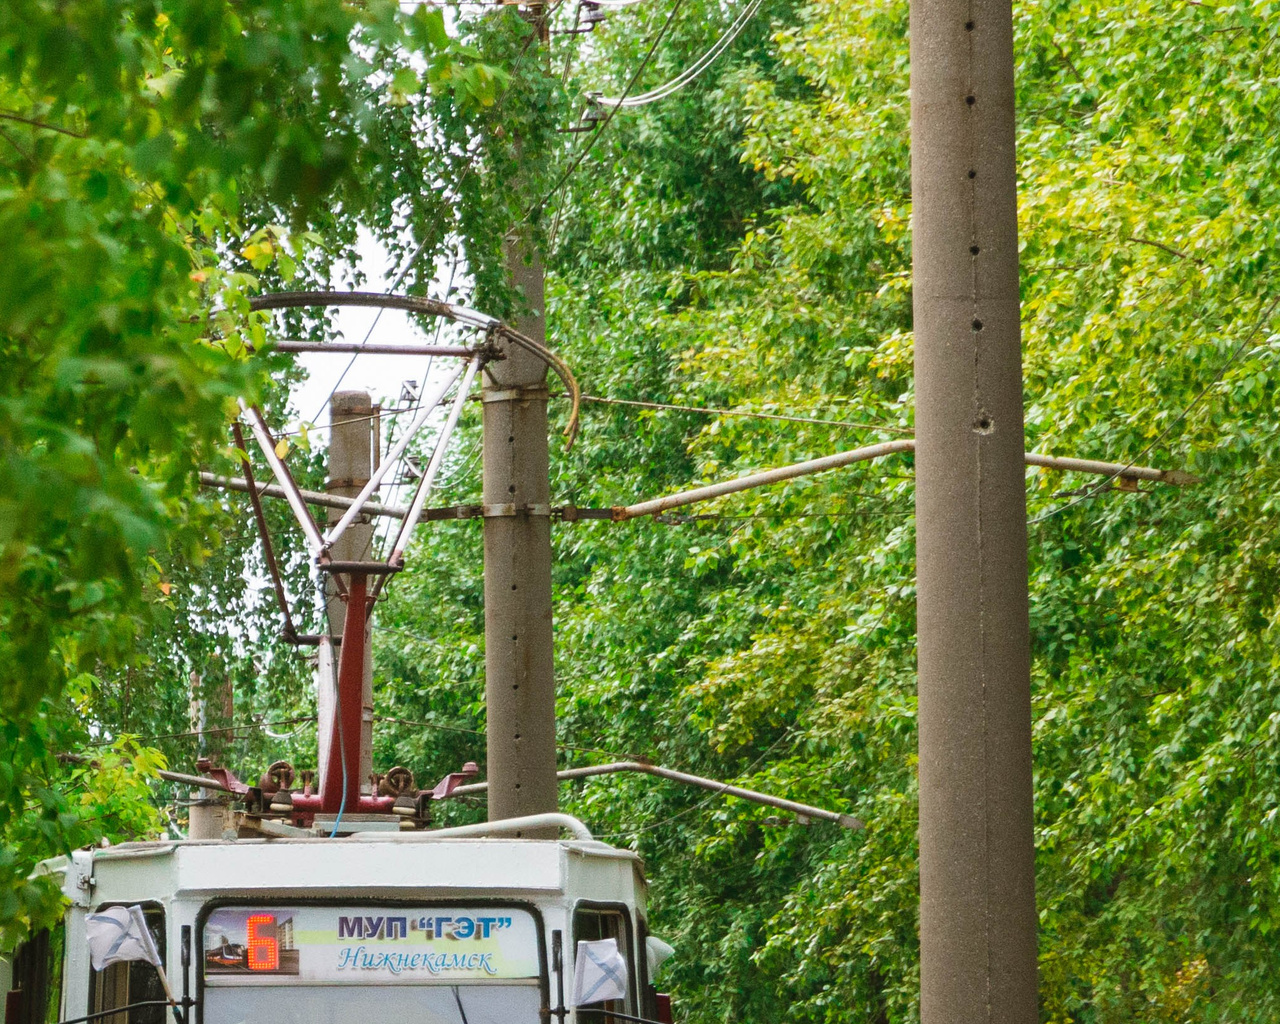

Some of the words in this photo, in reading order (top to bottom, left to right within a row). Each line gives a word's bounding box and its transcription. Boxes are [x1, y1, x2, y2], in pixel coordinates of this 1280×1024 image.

[338, 916, 407, 938] МУП
[247, 914, 278, 970] 6
[337, 946, 498, 974] Нижнекамск
